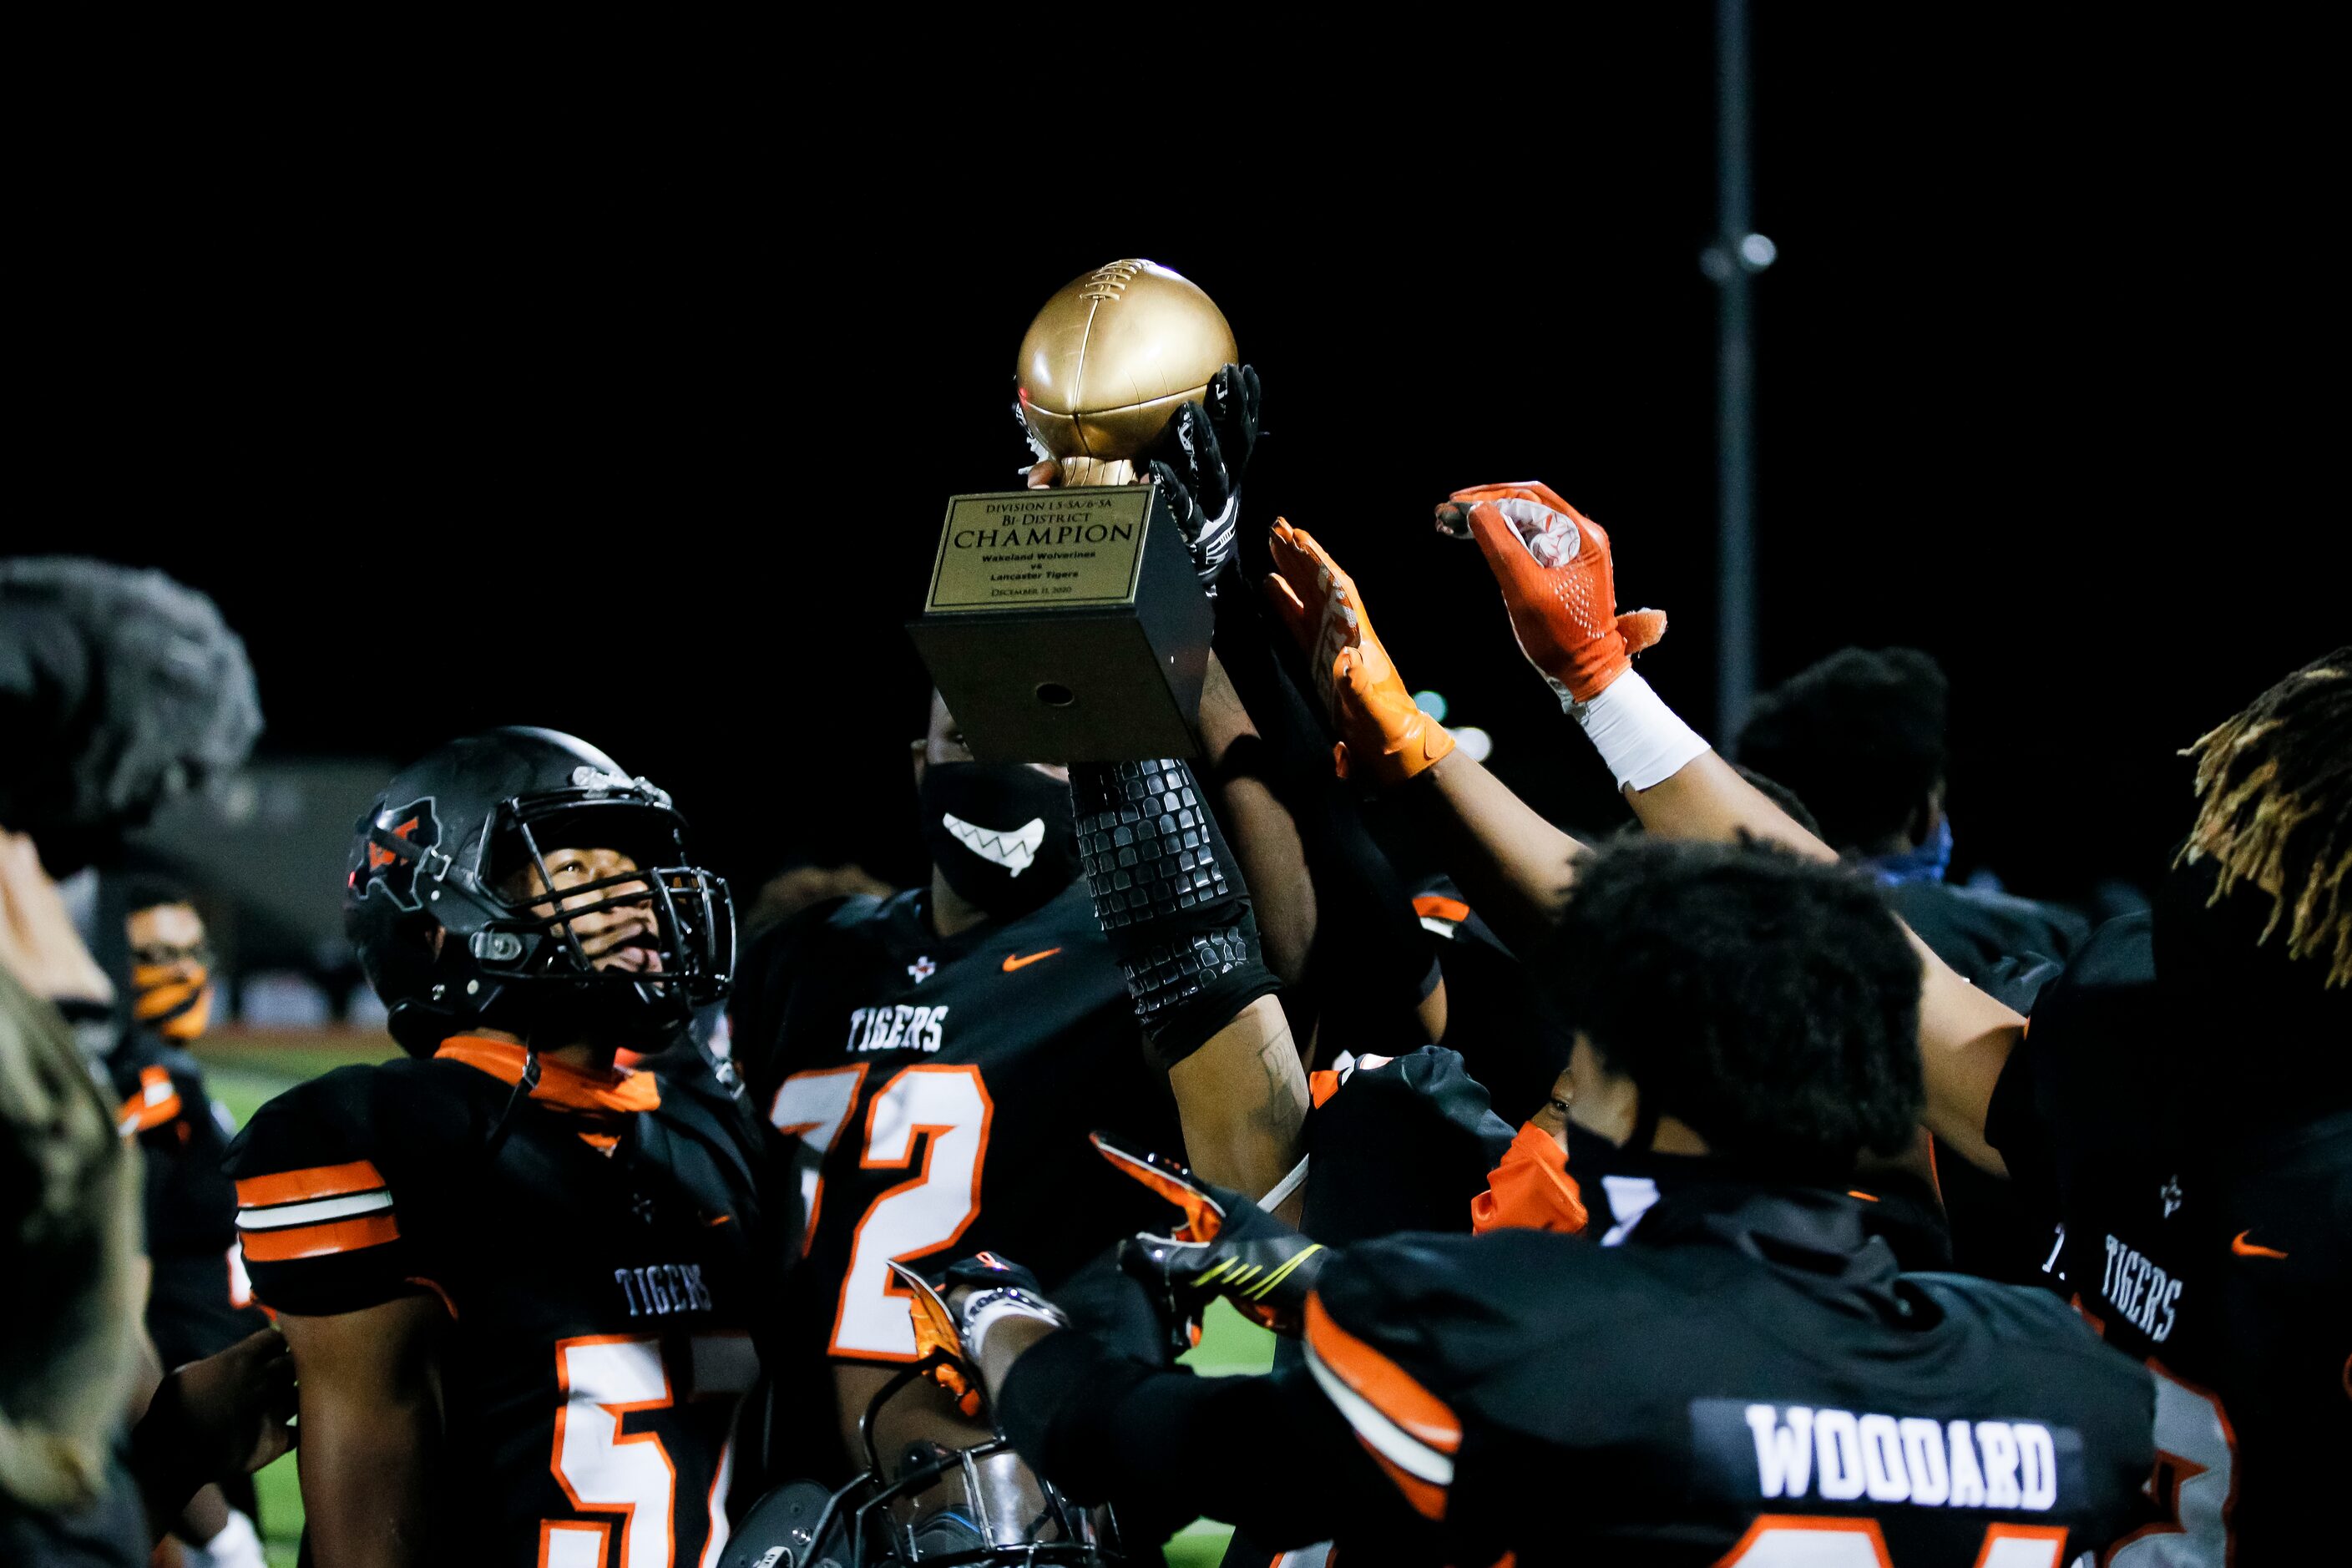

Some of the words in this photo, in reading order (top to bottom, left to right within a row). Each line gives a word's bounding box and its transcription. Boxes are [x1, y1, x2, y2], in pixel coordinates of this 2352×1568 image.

[986, 499, 1044, 513] DIVISION
[953, 524, 1134, 549] CHAMPION
[982, 553, 1034, 563] Wakeland
[1036, 551, 1096, 560] Wolverines
[990, 572, 1042, 581] Lancaster
[1046, 570, 1079, 579] Tigers
[846, 1004, 949, 1053] TIGERS
[769, 1061, 994, 1363] 72
[2101, 1234, 2183, 1343] TIGERS
[1745, 1404, 2057, 1510] WOODARD
